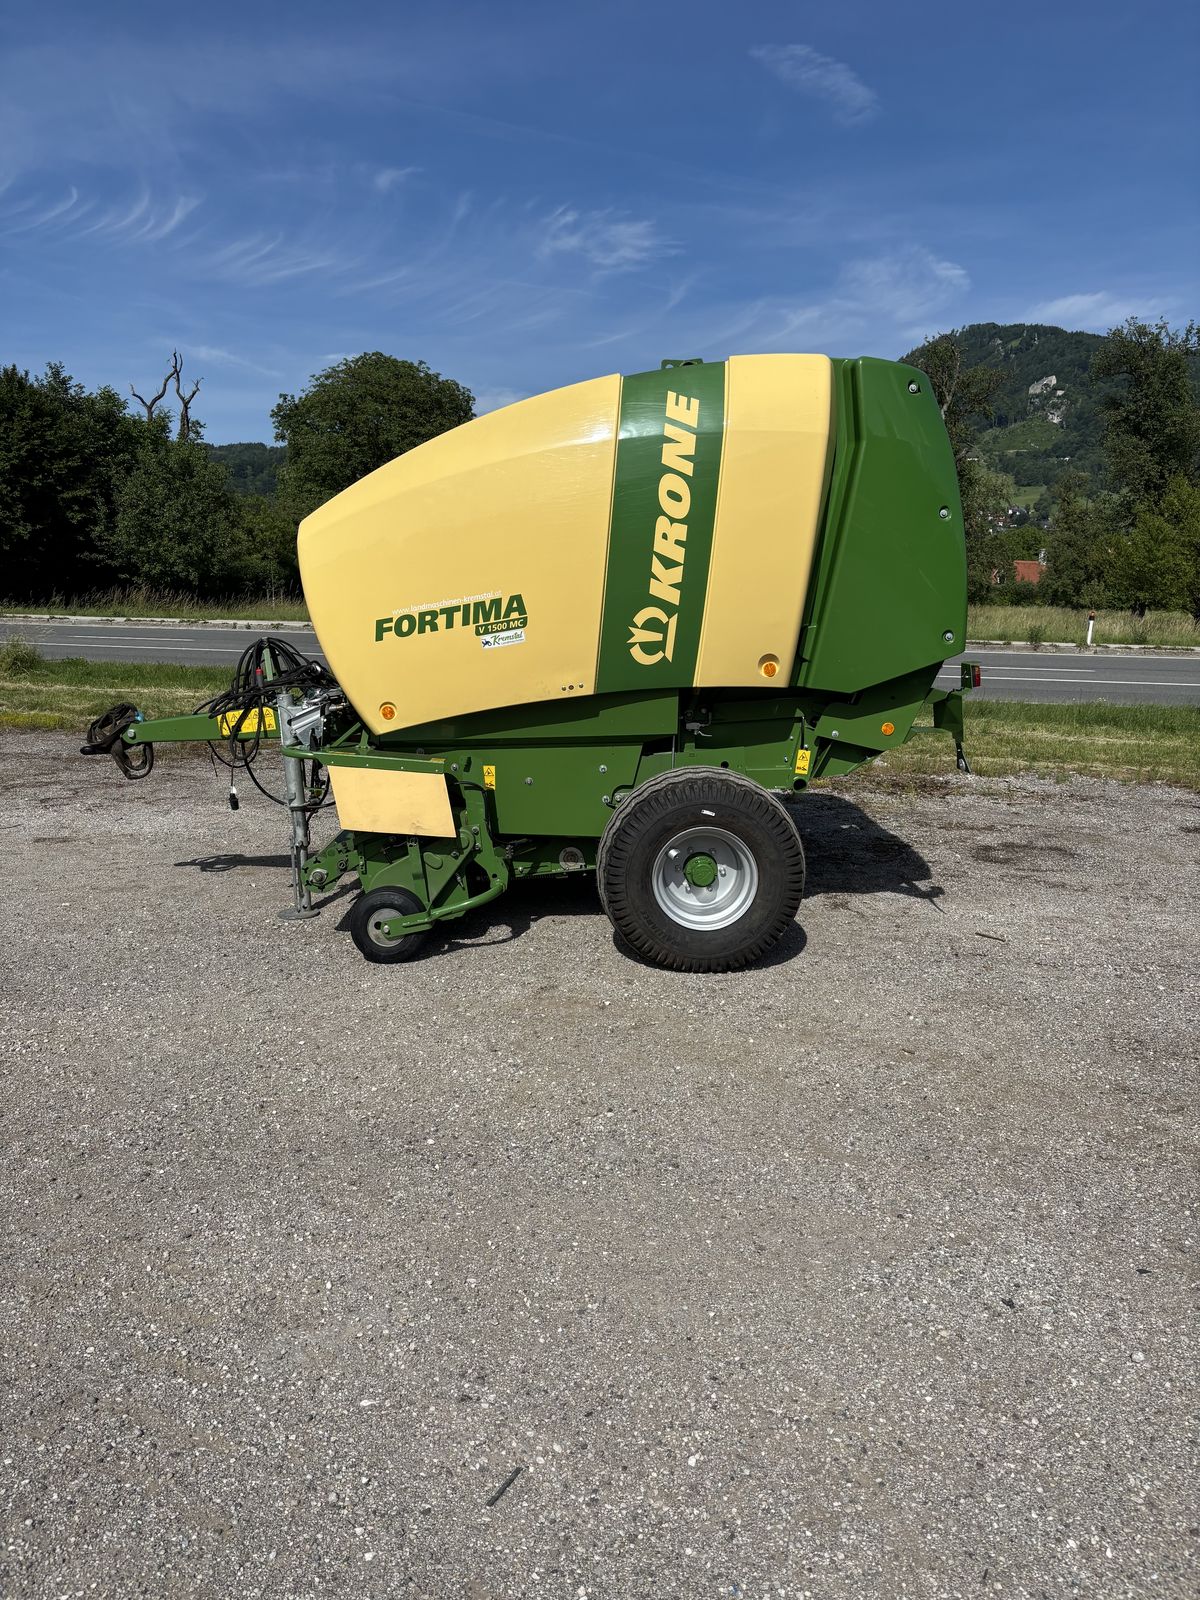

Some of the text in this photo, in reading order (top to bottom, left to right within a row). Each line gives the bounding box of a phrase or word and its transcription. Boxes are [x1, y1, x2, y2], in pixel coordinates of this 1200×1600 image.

[649, 391, 700, 606] KRONE
[375, 594, 527, 642] FORTIMA
[392, 590, 502, 615] www.landmaschinen-kremstal.at
[478, 619, 524, 634] V 1500 MC
